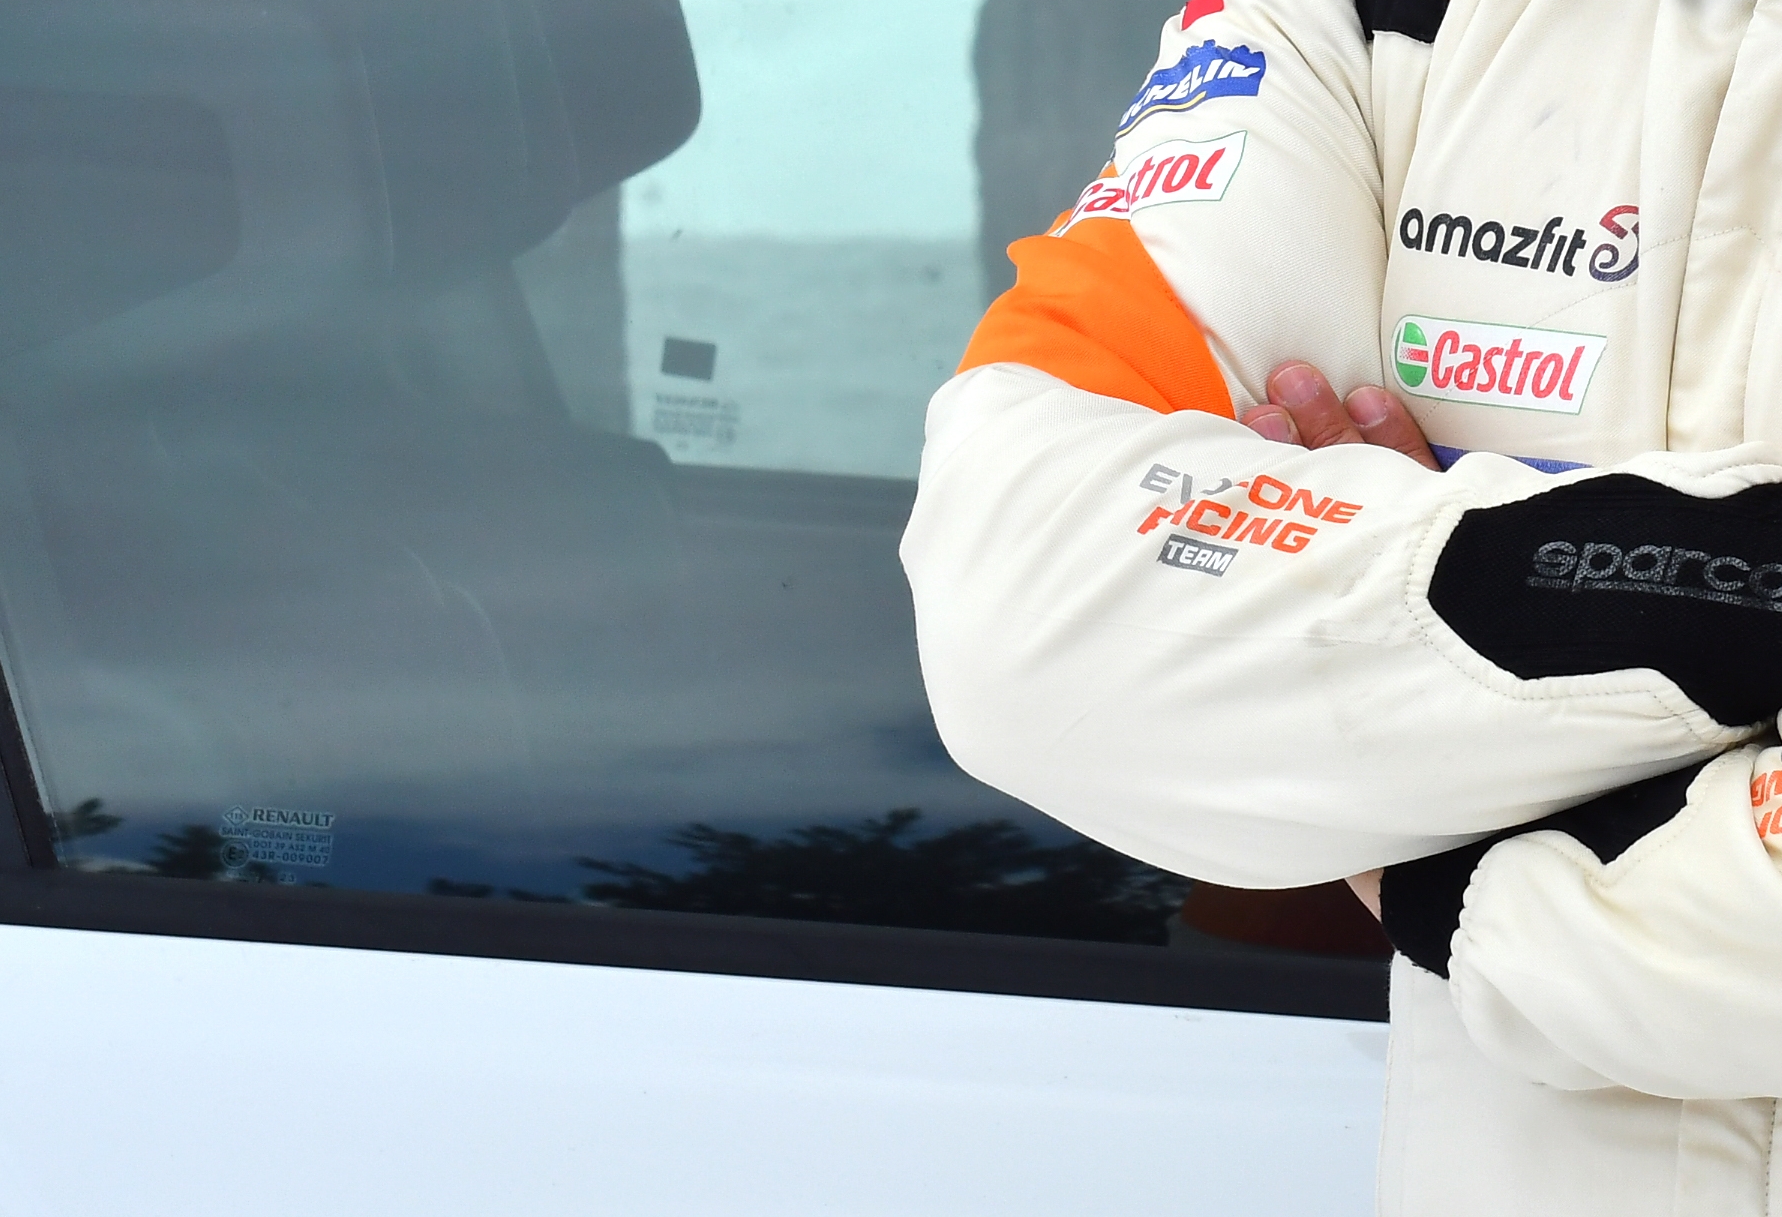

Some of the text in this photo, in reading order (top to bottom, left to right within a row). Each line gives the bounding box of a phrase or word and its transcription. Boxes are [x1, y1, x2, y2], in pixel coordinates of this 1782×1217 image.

[1399, 207, 1587, 277] amazfit
[1431, 329, 1586, 402] Castrol
[1165, 540, 1234, 572] TEAM
[252, 808, 334, 826] RENAULT
